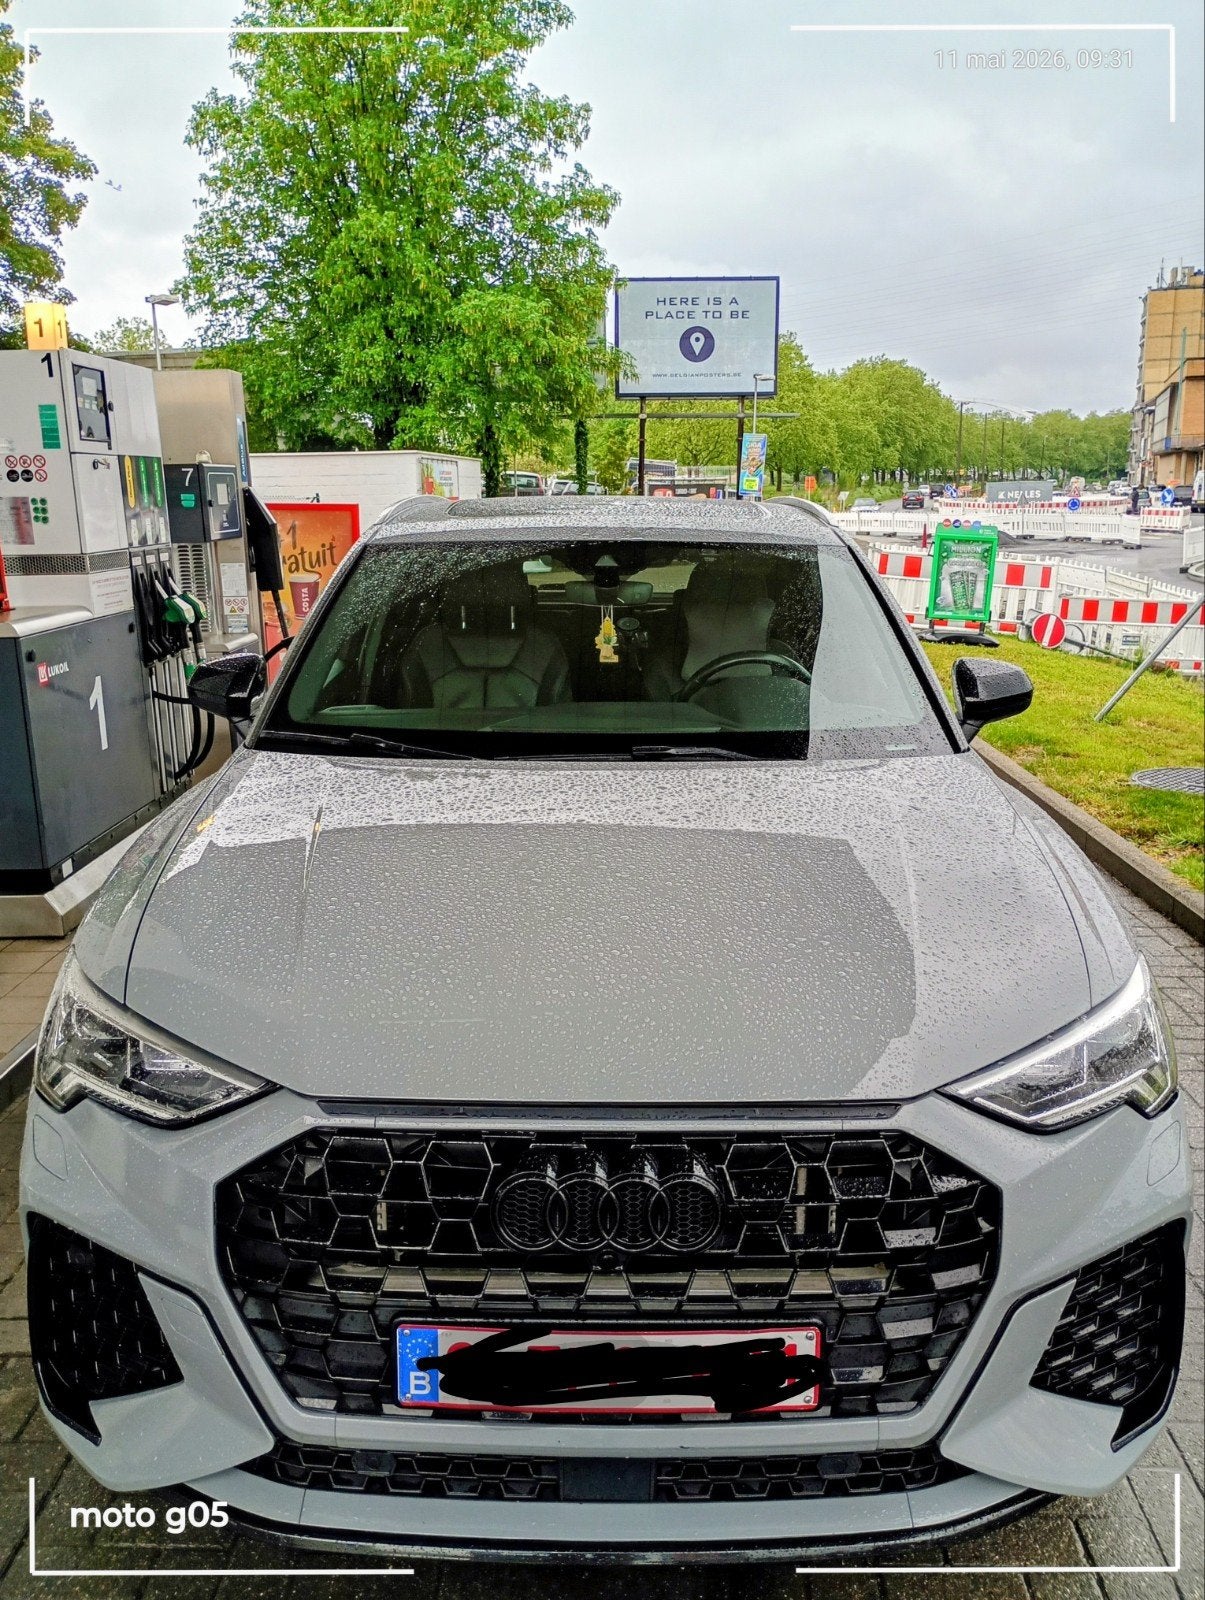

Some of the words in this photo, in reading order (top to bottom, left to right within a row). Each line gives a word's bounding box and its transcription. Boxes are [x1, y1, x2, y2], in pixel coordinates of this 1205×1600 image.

[656, 297, 700, 306] HERE
[707, 297, 722, 306] IS
[729, 297, 739, 306] A
[645, 311, 696, 320] PLACE
[702, 311, 722, 320] TO
[730, 310, 750, 319] BE
[34, 318, 44, 338] 1
[57, 320, 63, 339] 1
[41, 353, 54, 378] 1
[181, 467, 194, 487] 7
[301, 587, 309, 613] COSTA
[47, 661, 70, 678] LUKOIL
[89, 675, 109, 750] 1
[409, 1371, 431, 1395] B
